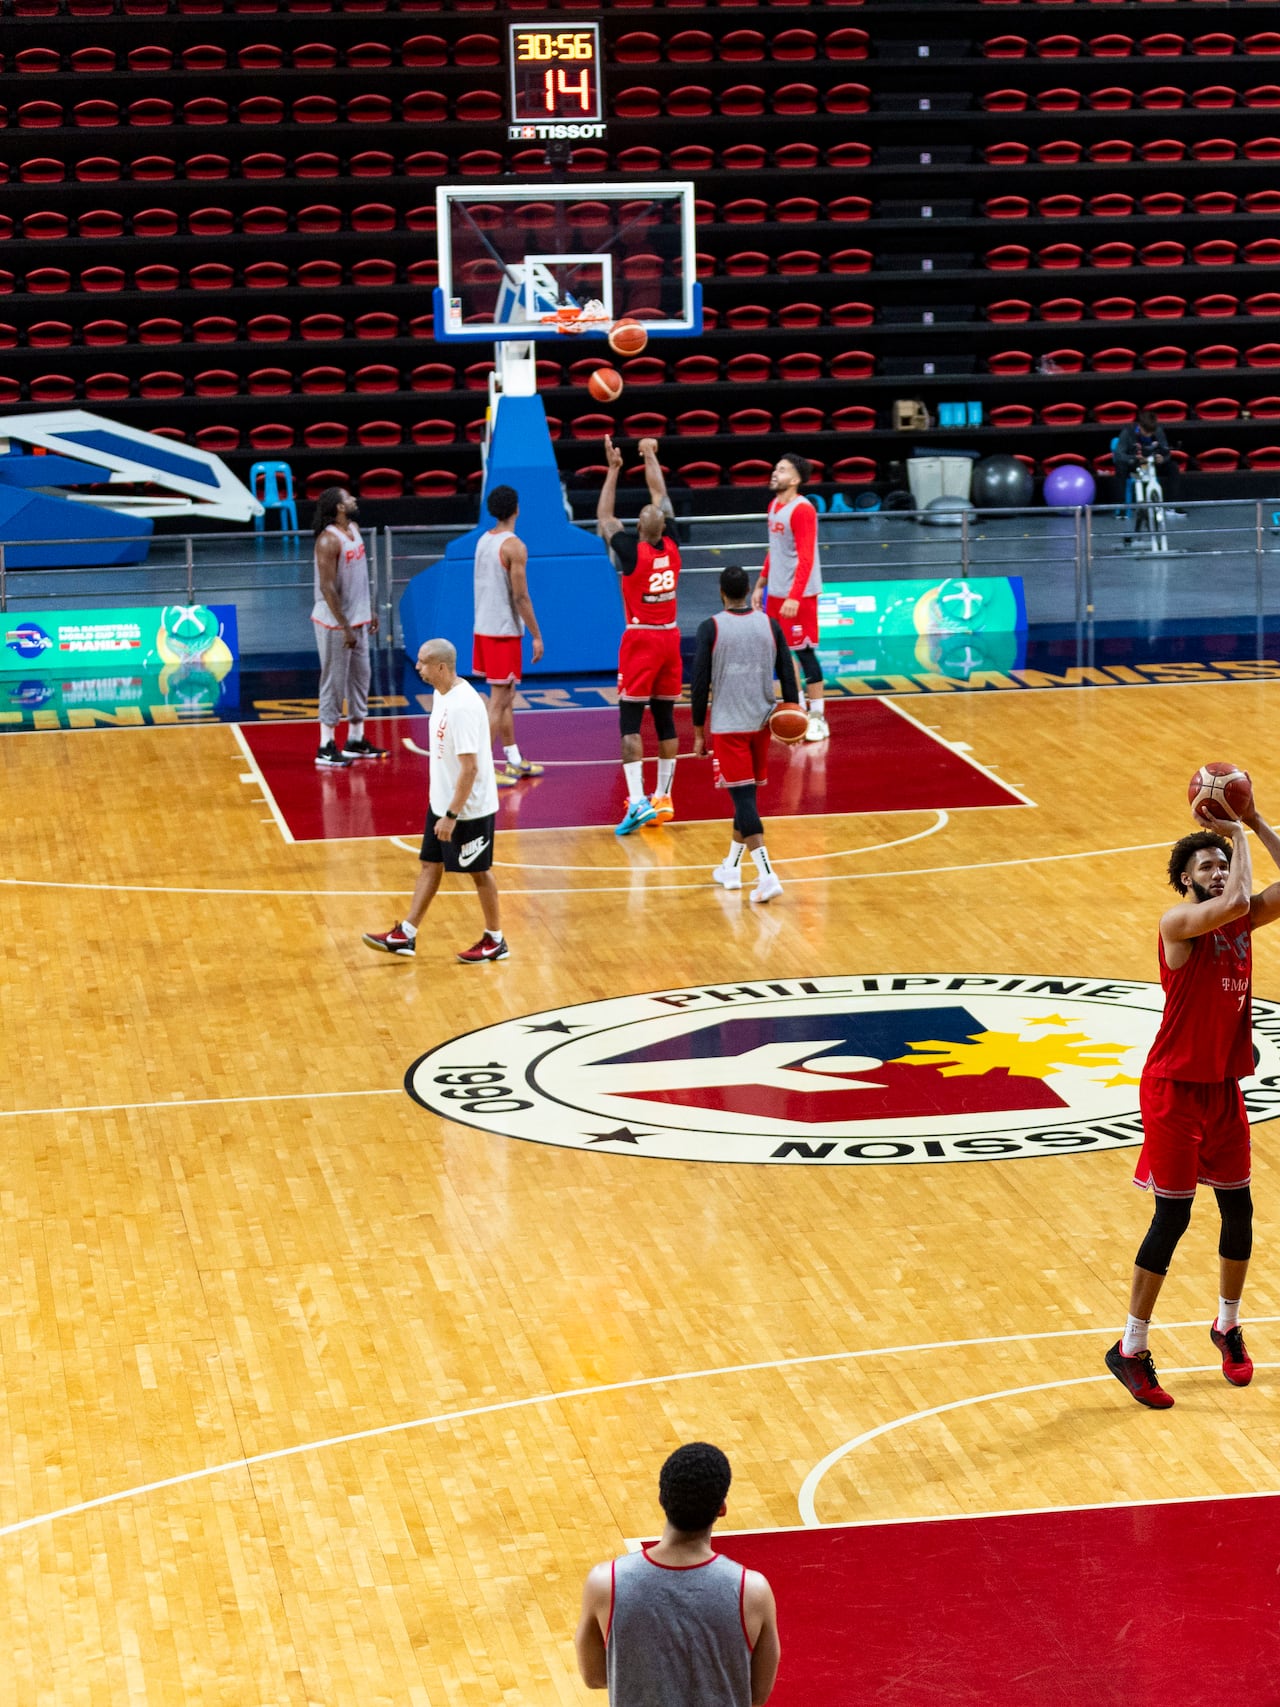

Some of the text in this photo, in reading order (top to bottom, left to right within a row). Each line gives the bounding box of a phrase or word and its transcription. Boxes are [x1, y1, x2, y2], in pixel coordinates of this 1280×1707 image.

[517, 33, 593, 60] 30:56
[545, 68, 590, 111] 14
[535, 124, 607, 139] TISSOT
[648, 570, 675, 593] 28
[461, 835, 485, 858] NIKE
[647, 977, 1149, 1008] PHILIPPINE
[433, 1061, 534, 1114] 1990
